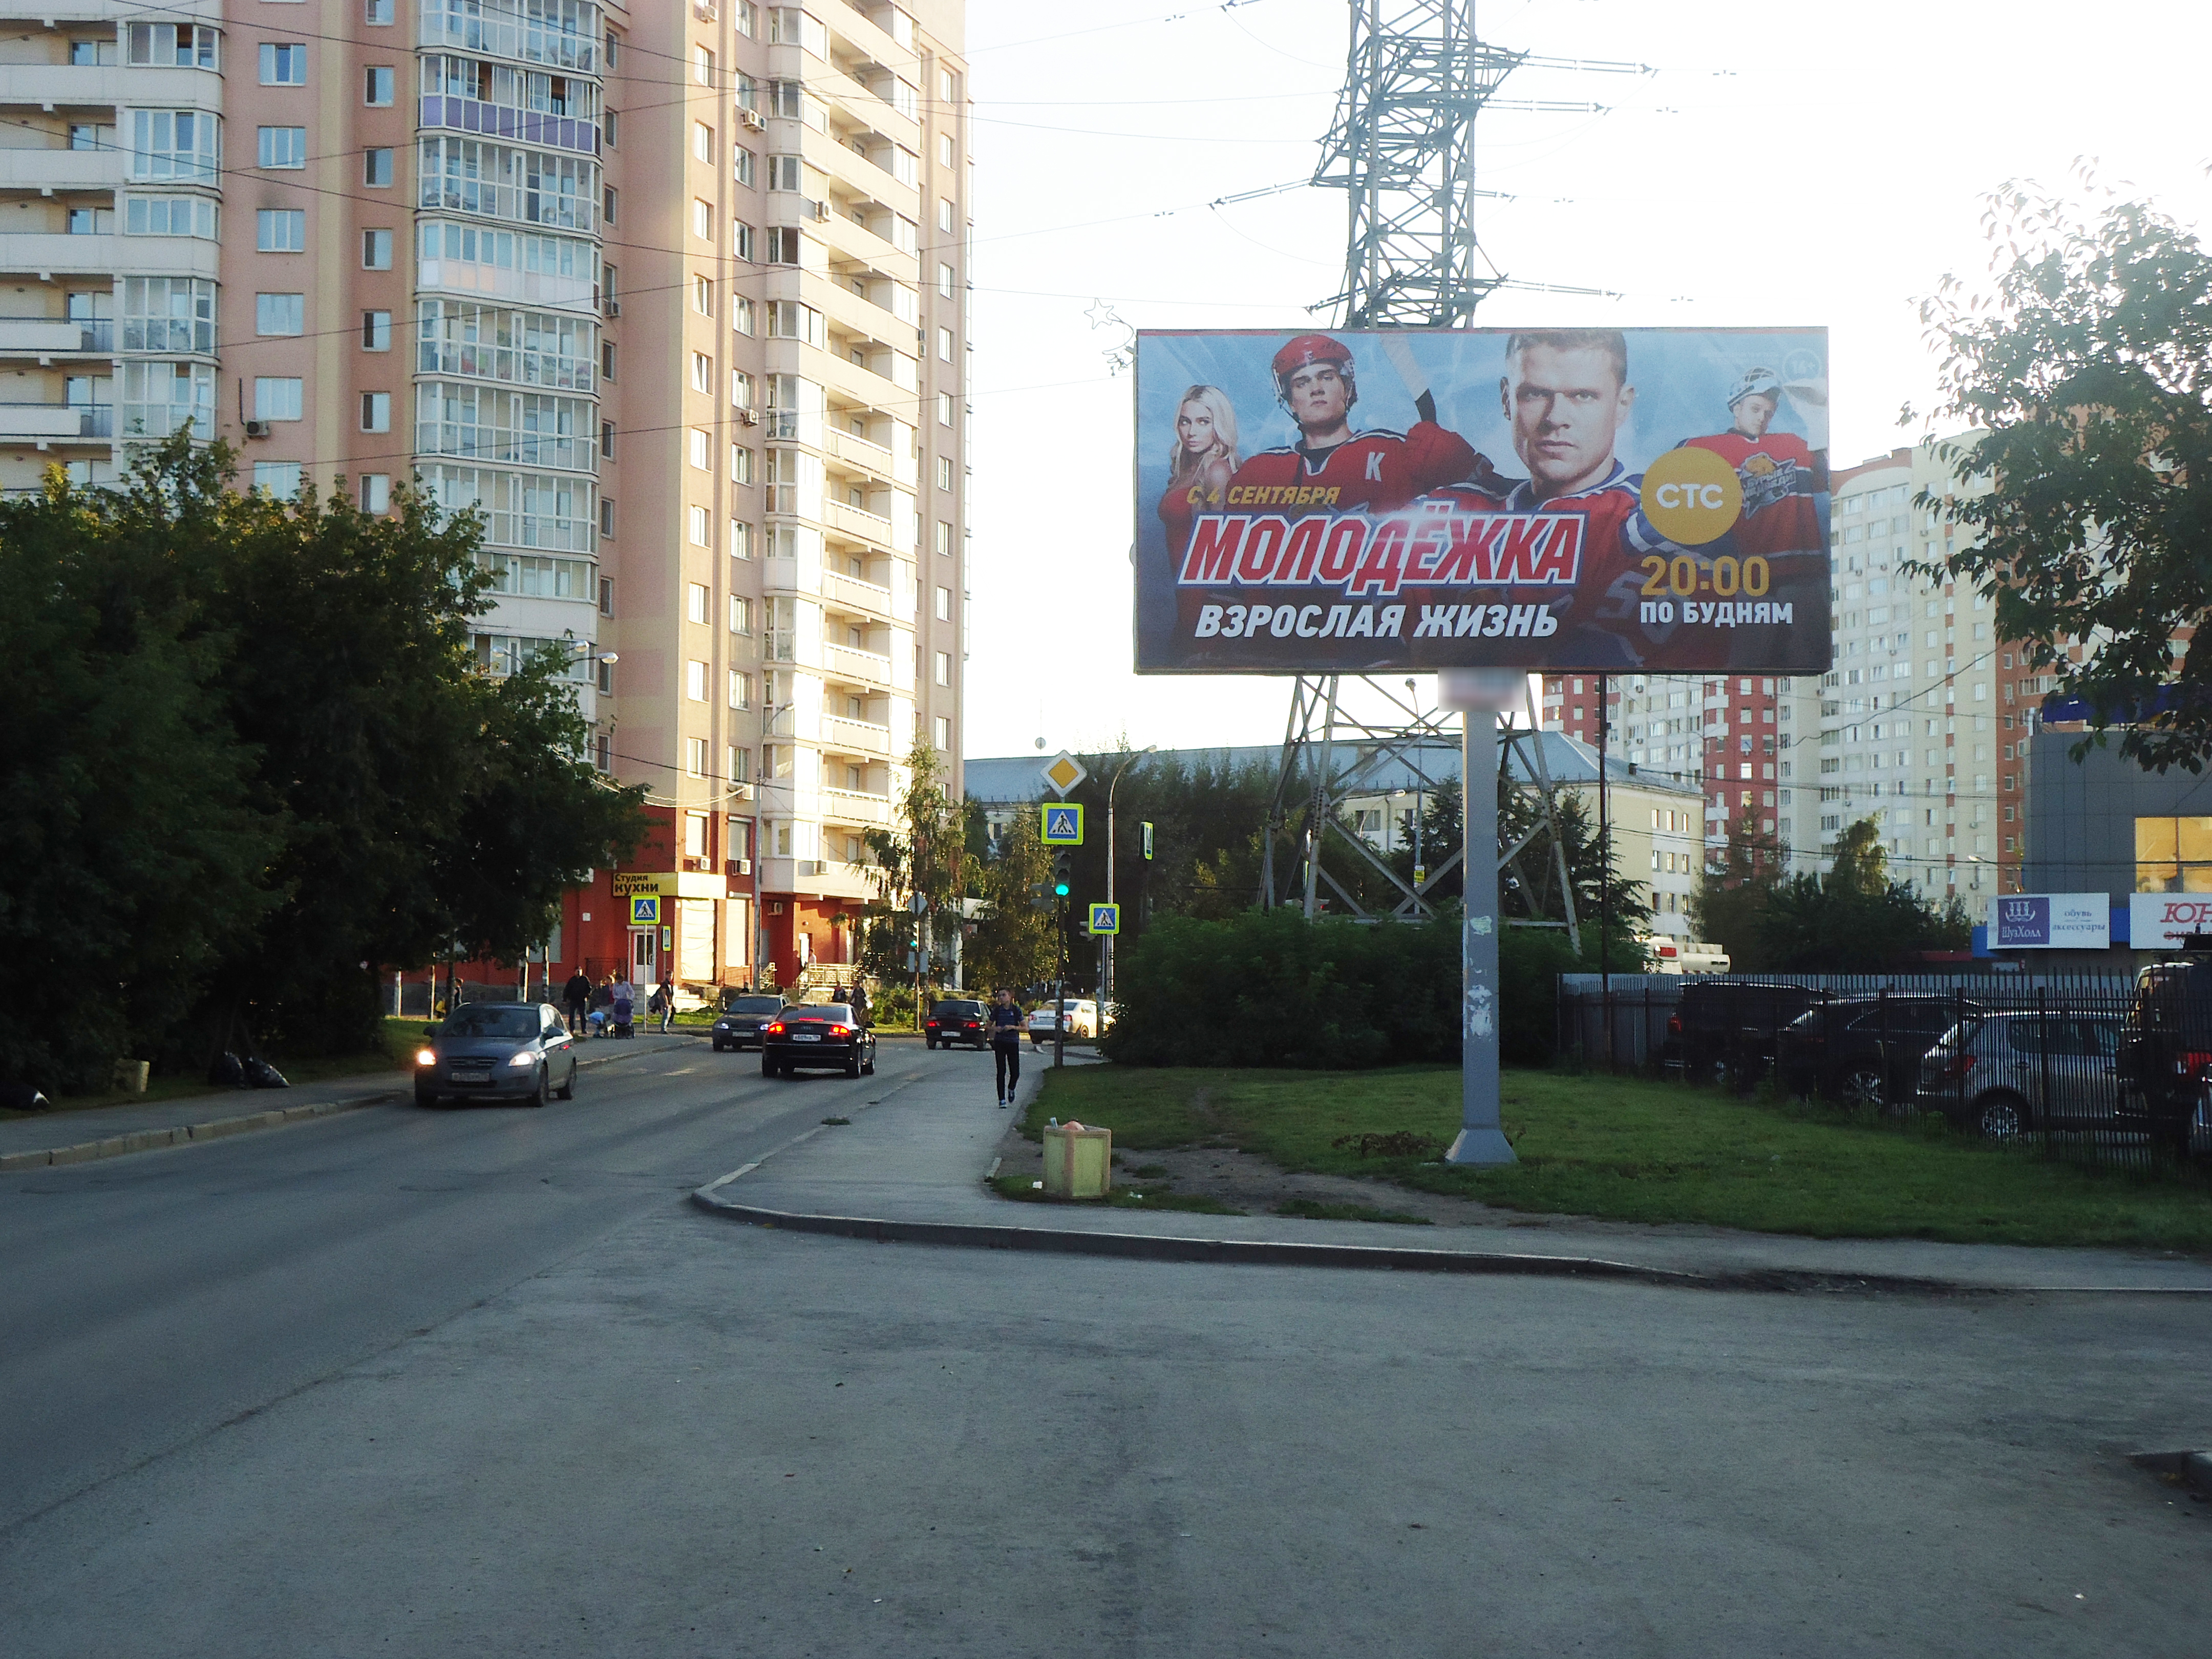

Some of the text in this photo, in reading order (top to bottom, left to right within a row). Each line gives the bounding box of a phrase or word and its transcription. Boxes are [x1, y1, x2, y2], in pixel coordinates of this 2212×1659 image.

[1186, 486, 1341, 505] С 4 СЕНТЯБРЯ
[1656, 483, 1724, 509] СТС
[1178, 501, 1585, 595] МОЛОДЁЖКА
[1641, 556, 1770, 597] 20:00
[1195, 604, 1558, 638] ВЗРОСЛАЯ ЖИЗНЬ
[1641, 602, 1793, 628] ПО БУДНЯМ
[615, 874, 649, 883] Студия
[2065, 909, 2092, 919] обувь
[2002, 925, 2041, 942] ШузХолл
[2052, 924, 2105, 933] аксессуары
